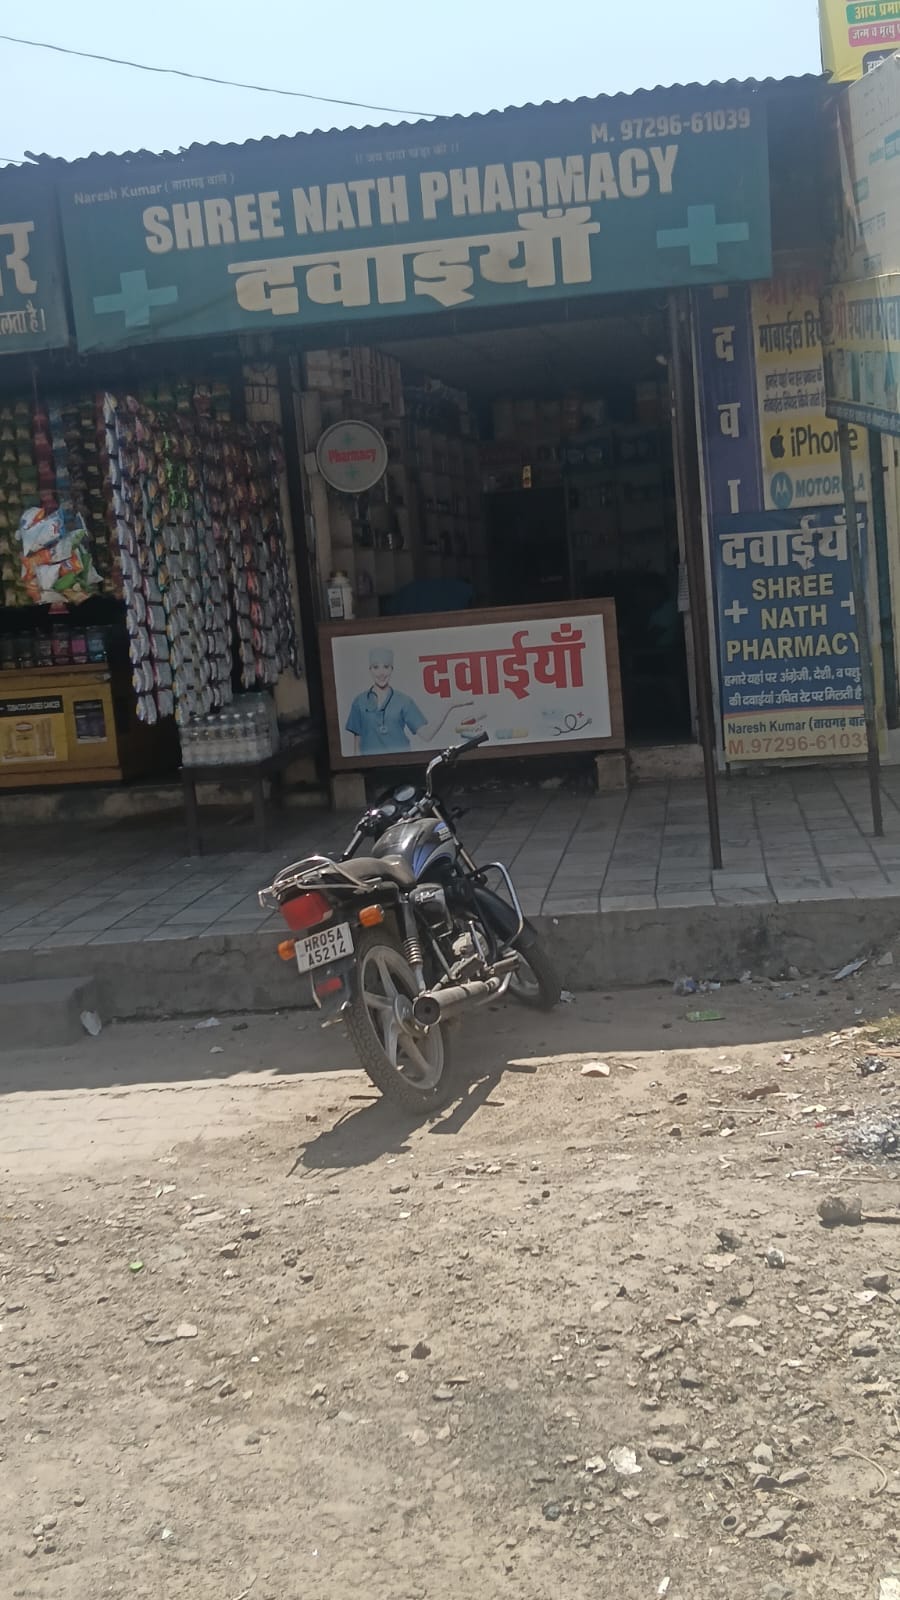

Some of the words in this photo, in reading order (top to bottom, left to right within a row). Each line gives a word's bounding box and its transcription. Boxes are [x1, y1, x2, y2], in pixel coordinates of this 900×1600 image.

[854, 5, 877, 20] आय
[591, 122, 615, 145] M.
[620, 108, 751, 141] 97296-61039
[73, 188, 118, 205] Naresh
[121, 183, 163, 198] Kumar
[142, 190, 285, 255] SHREE
[292, 174, 411, 236] NATH
[420, 144, 679, 221] PHARMACY
[790, 423, 858, 457] iPhone
[795, 473, 865, 498] MOTORA
[752, 573, 834, 601] SHREE
[760, 604, 828, 630] NATH
[418, 622, 587, 700] दवाईयाँ
[724, 671, 746, 687] हमारे
[765, 672, 777, 684] पर
[775, 689, 798, 704] उचित
[811, 691, 824, 702] पर
[824, 685, 853, 701] मिलती
[727, 720, 767, 735] Naresh
[768, 719, 806, 734] Kumar
[727, 732, 867, 756] M.97296-6103
[303, 927, 344, 953] HR05A
[308, 941, 347, 966] A5214
